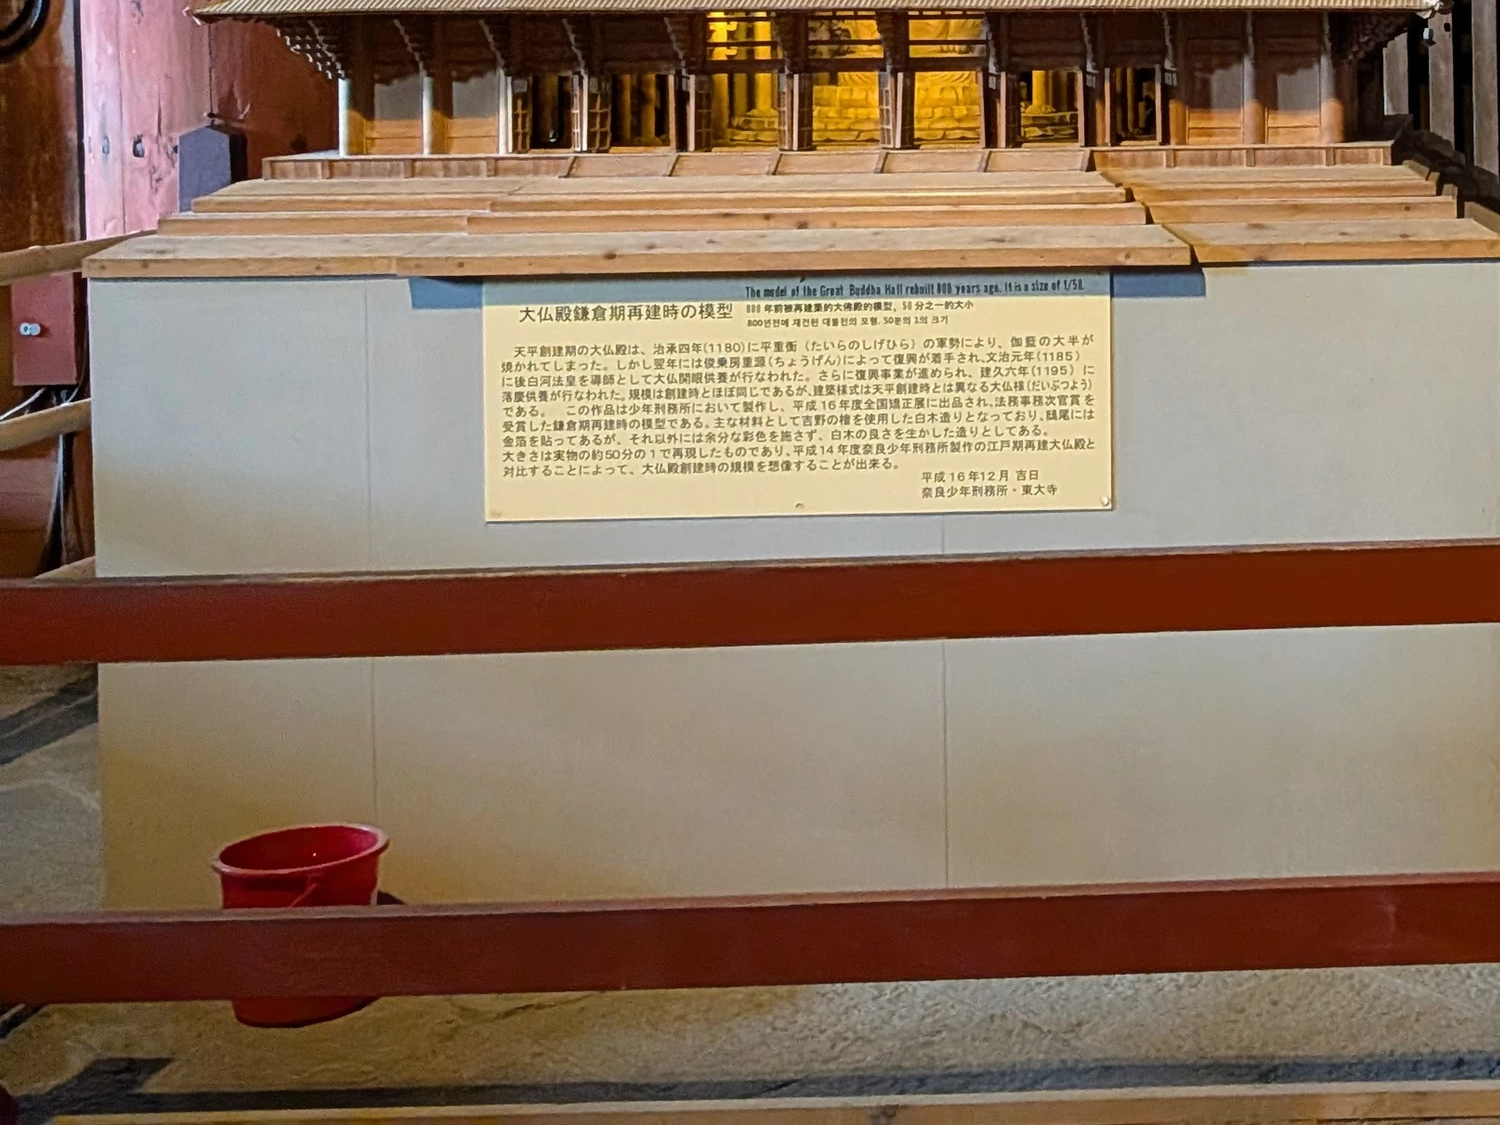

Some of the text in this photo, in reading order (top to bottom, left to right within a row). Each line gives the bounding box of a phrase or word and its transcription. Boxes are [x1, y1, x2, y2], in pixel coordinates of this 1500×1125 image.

[746, 286, 761, 298] The
[763, 285, 787, 298] model
[791, 285, 800, 297] of
[803, 285, 817, 297] the
[819, 284, 844, 296] Great
[849, 283, 881, 296] Buddha
[884, 283, 903, 295] Hall
[905, 283, 935, 295] rebuilt
[955, 284, 981, 295] years
[1031, 279, 1049, 292] size
[1051, 279, 1061, 291] of
[519, 302, 734, 323] 大仏殿鎌倉期再建時の模型
